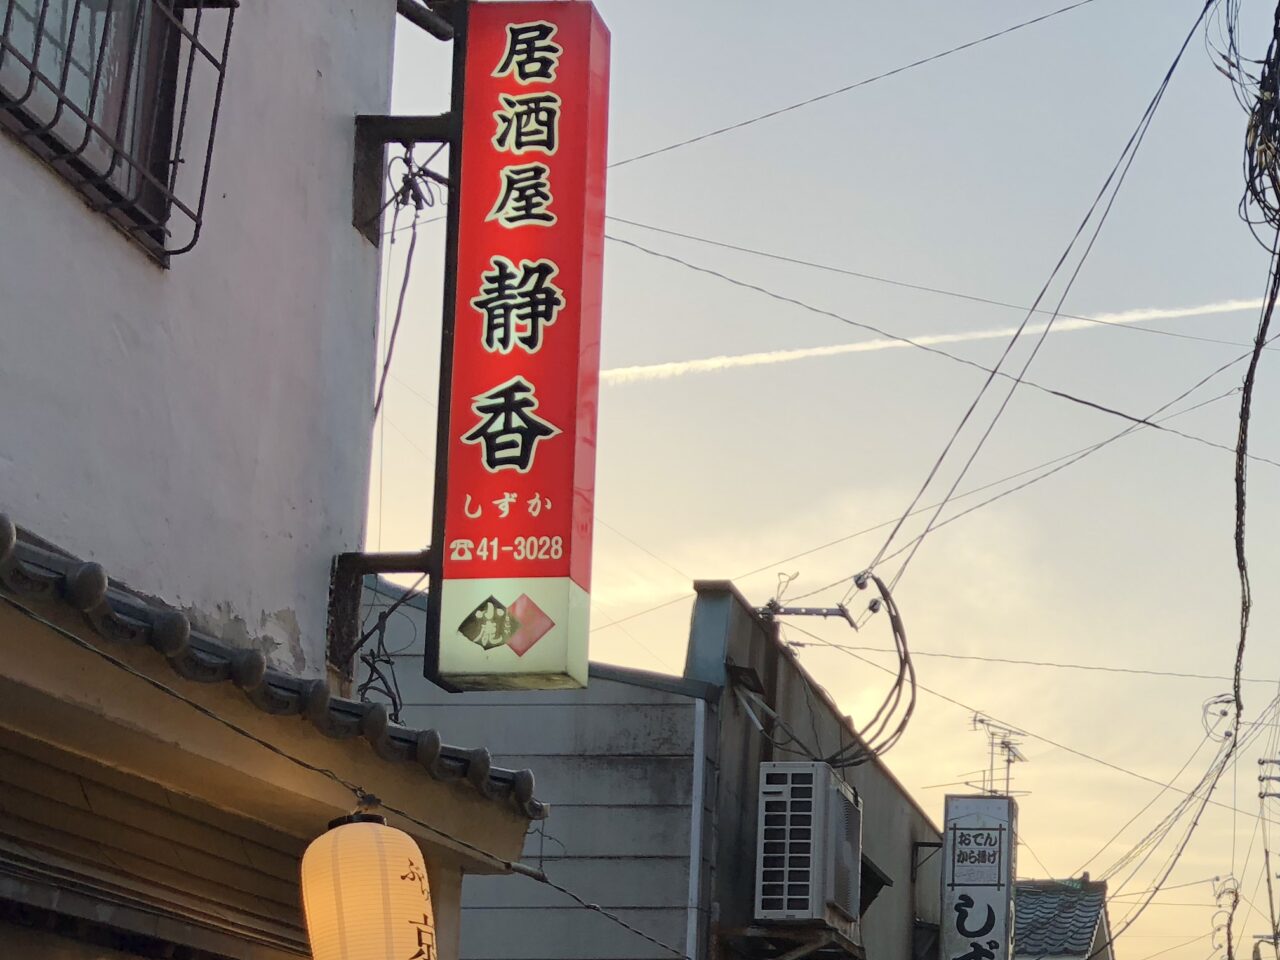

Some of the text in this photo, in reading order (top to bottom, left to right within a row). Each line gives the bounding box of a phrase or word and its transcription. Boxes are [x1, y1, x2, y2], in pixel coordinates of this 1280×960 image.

[461, 20, 564, 473] 居酒屋 静香
[463, 493, 553, 518] しずか
[477, 535, 563, 562] 41-3028
[474, 602, 504, 646] 小鹿
[958, 831, 997, 847] おでん
[957, 849, 997, 866] から揚げ
